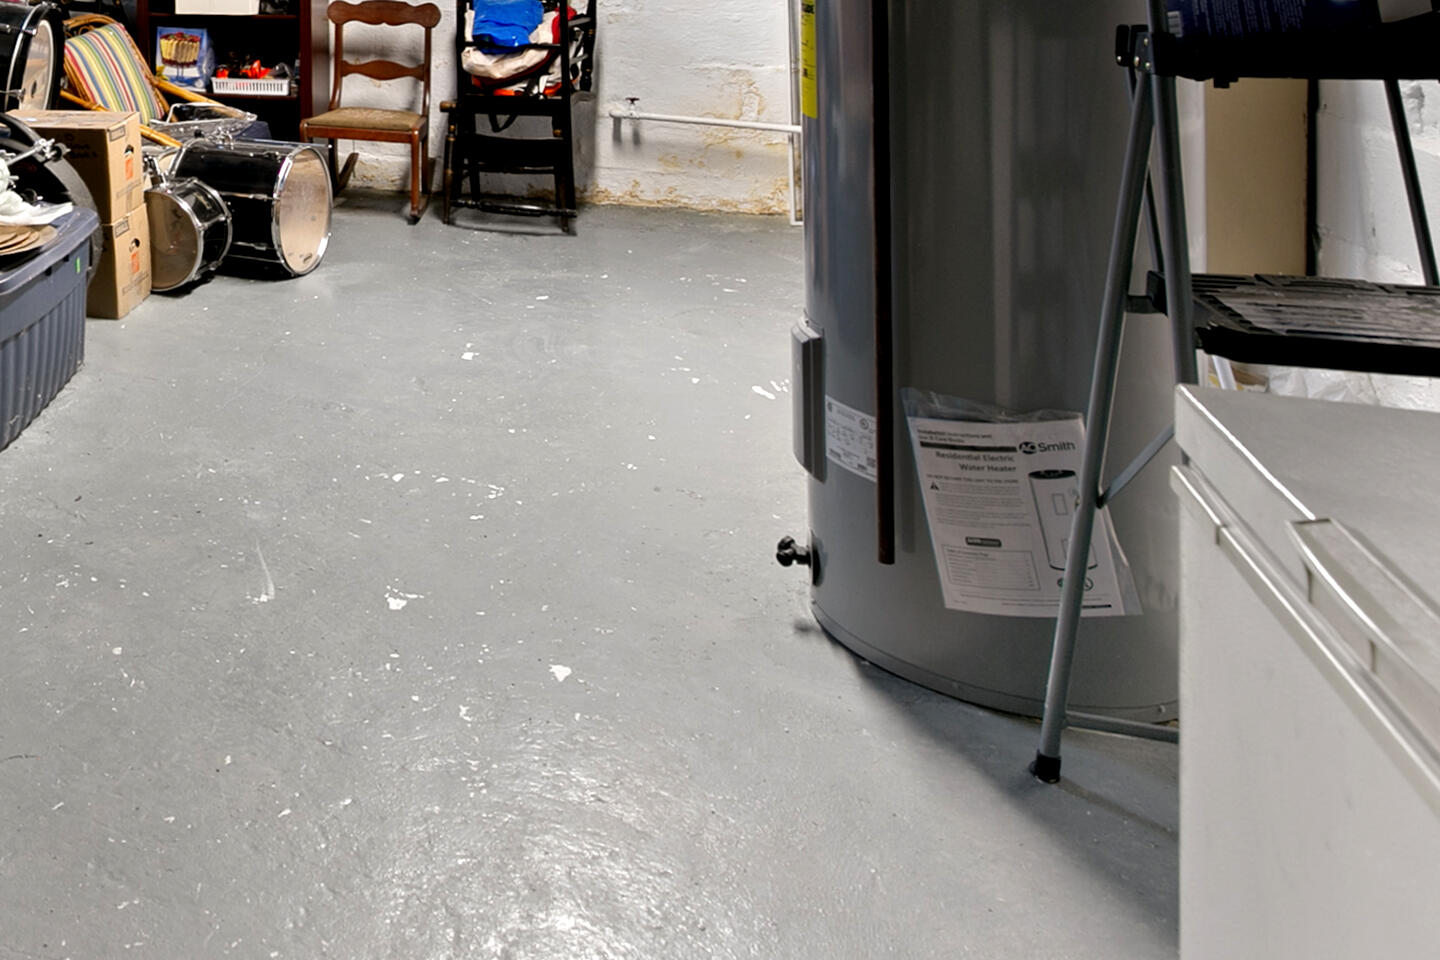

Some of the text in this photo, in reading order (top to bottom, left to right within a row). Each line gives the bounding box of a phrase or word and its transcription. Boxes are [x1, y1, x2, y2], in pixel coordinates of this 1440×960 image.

[1038, 441, 1076, 453] Smith
[935, 451, 1015, 463] Residential Electric
[959, 464, 985, 472] Water
